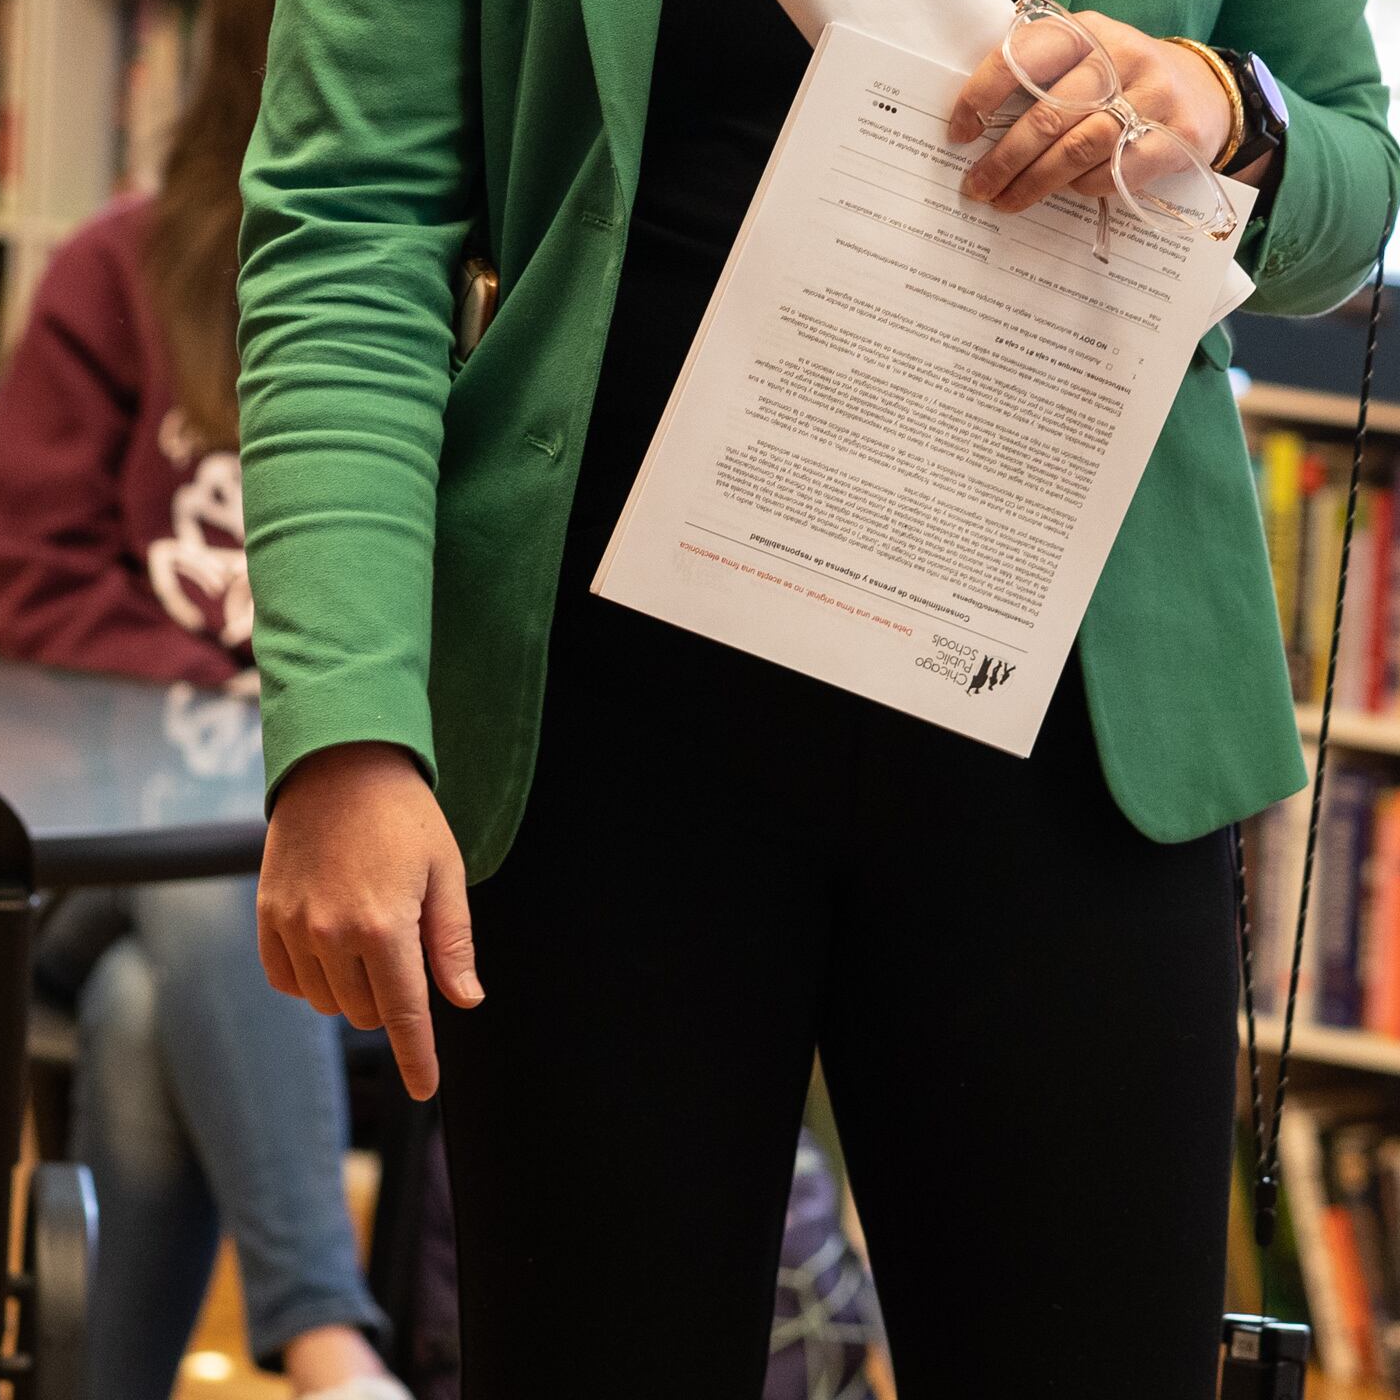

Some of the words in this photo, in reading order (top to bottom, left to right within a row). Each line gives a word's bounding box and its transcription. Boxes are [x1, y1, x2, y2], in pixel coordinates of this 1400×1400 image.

[994, 335, 1004, 344] #2
[1004, 339, 1019, 349] caja
[1034, 351, 1049, 361] caja
[1049, 357, 1057, 366] la
[1056, 360, 1084, 375] marque
[748, 532, 813, 561] responsabilidad
[812, 557, 824, 566] de
[824, 560, 861, 580] dispensa
[861, 573, 869, 582] y
[868, 577, 897, 593] prensa
[896, 588, 908, 598] de
[908, 593, 970, 623] Consentimiento
[931, 633, 979, 661] Schools
[935, 649, 973, 673] Public
[914, 656, 968, 686] Chicago
